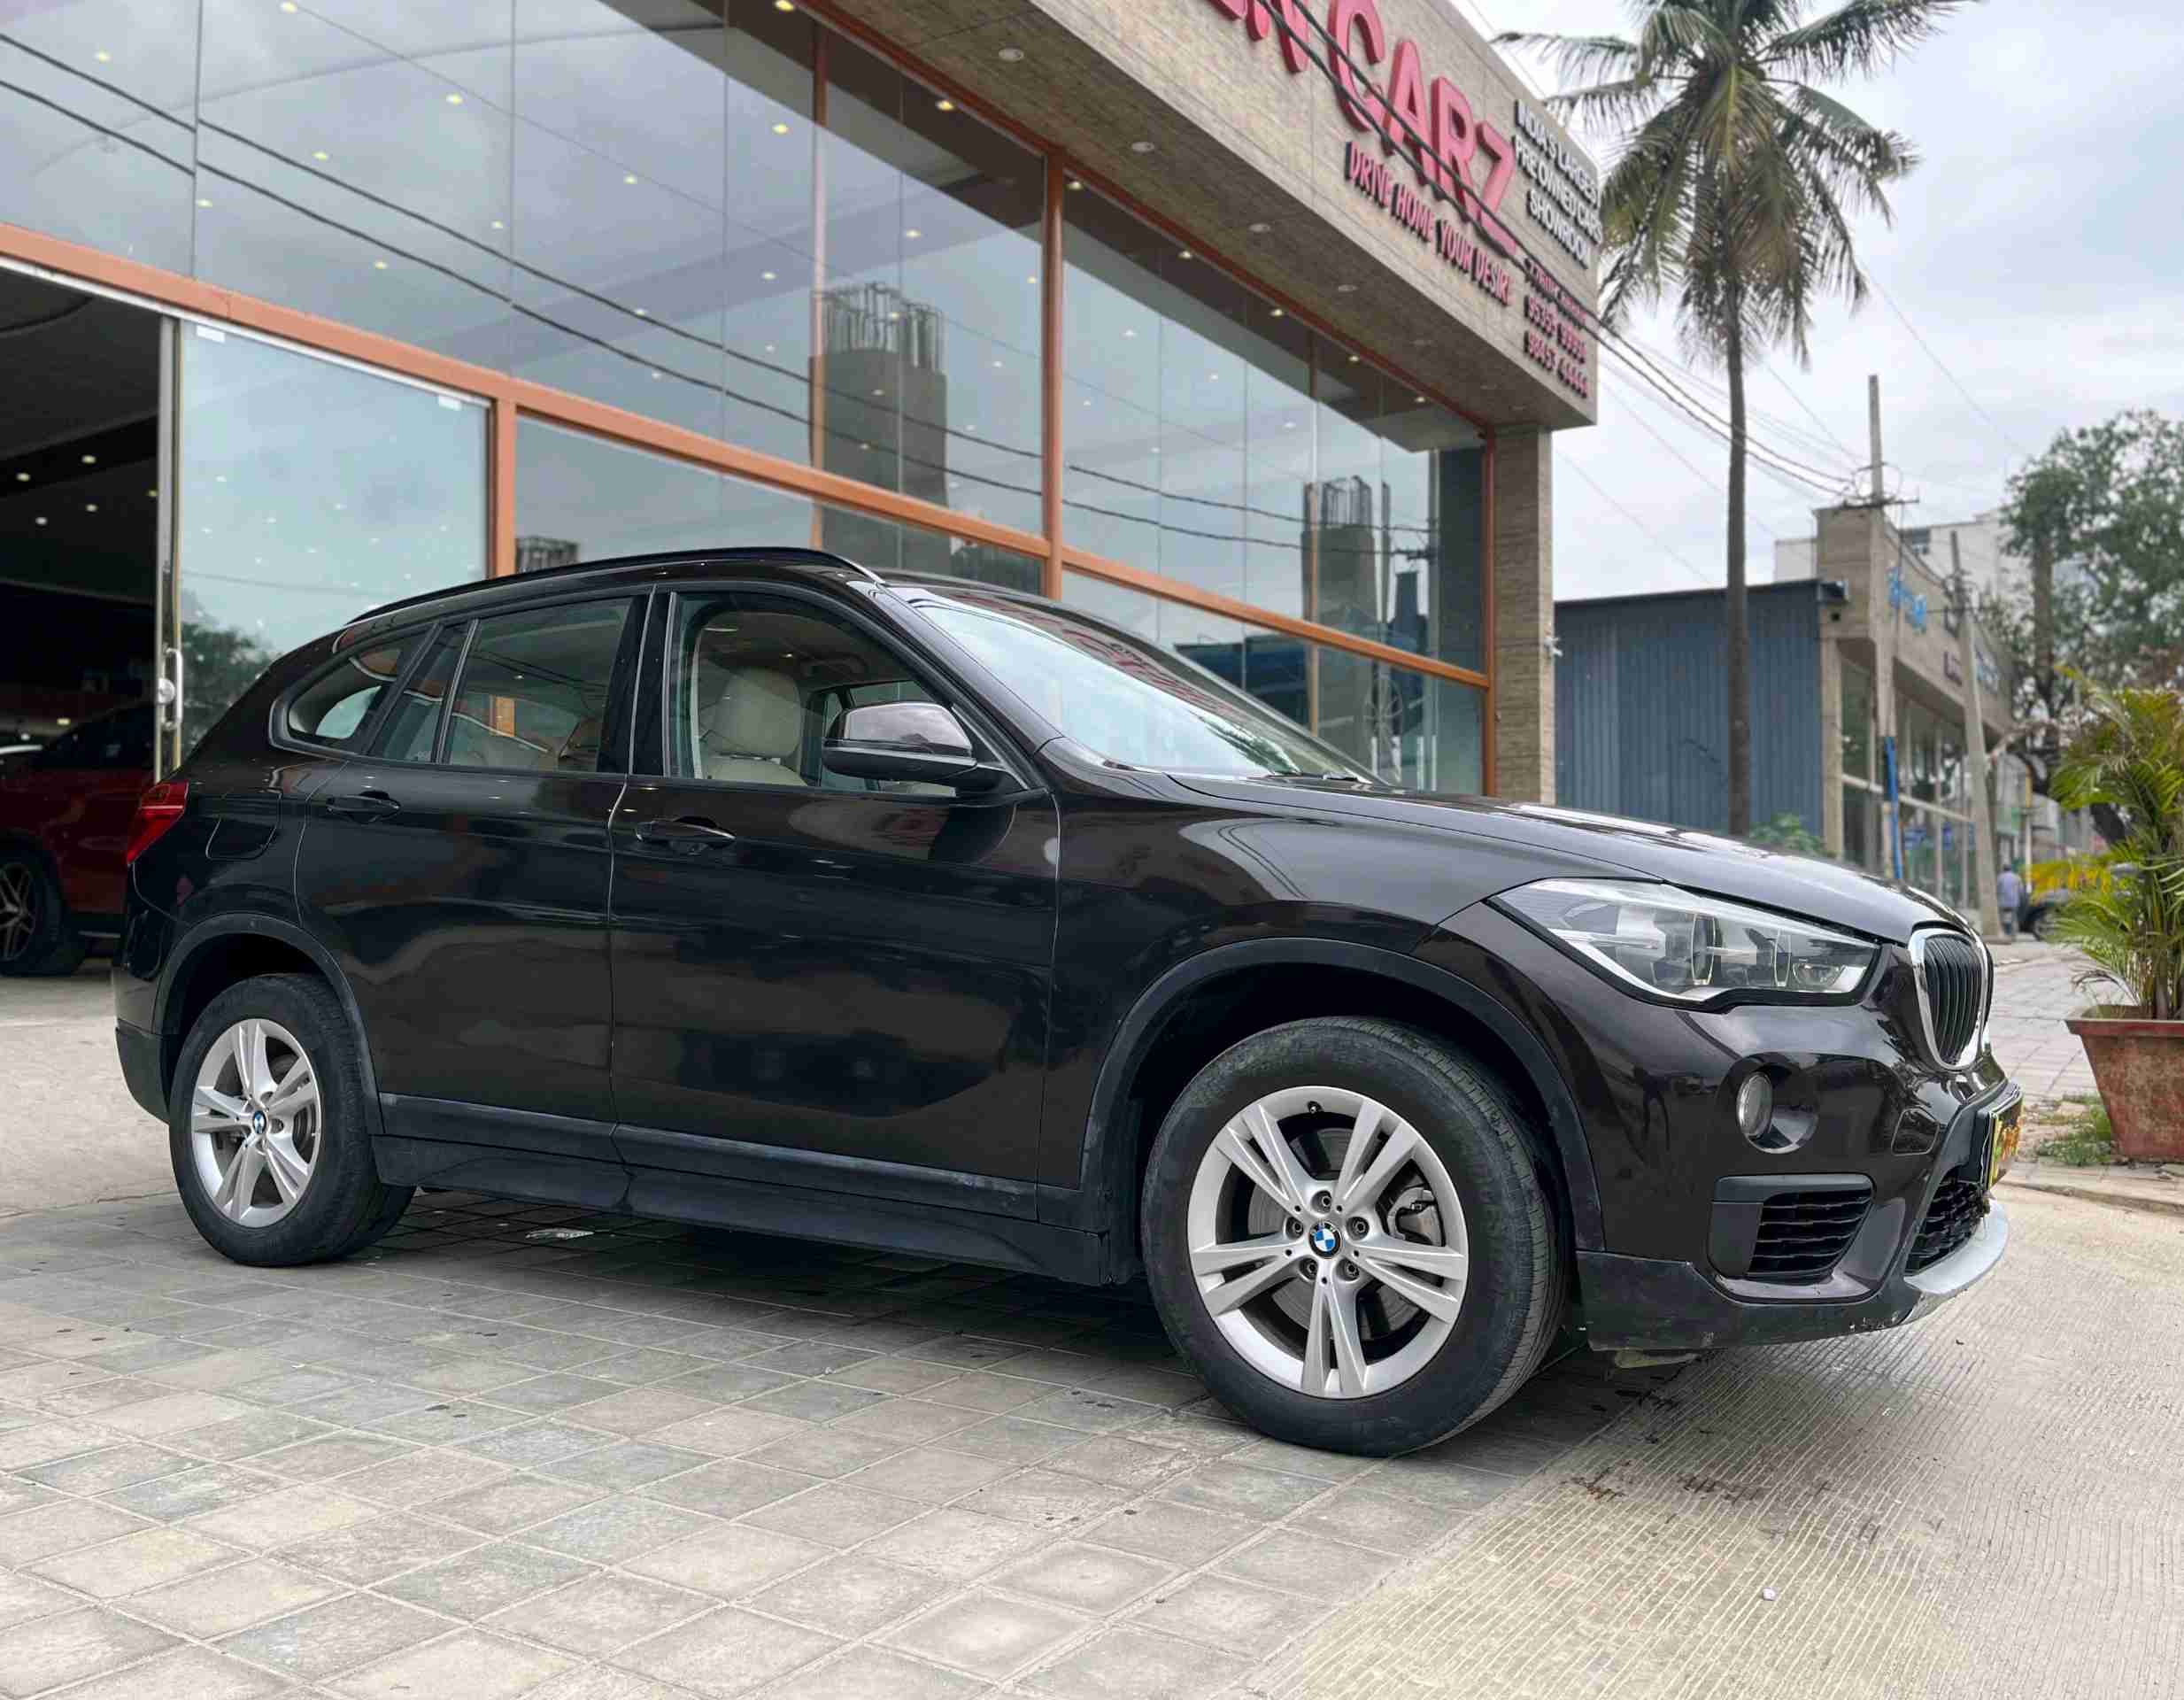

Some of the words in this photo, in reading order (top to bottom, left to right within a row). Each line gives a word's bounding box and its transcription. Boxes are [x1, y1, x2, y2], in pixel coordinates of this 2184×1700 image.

[1327, 0, 1516, 257] CARZ
[1438, 220, 1473, 274] YOUR
[1576, 202, 1603, 244] CARS
